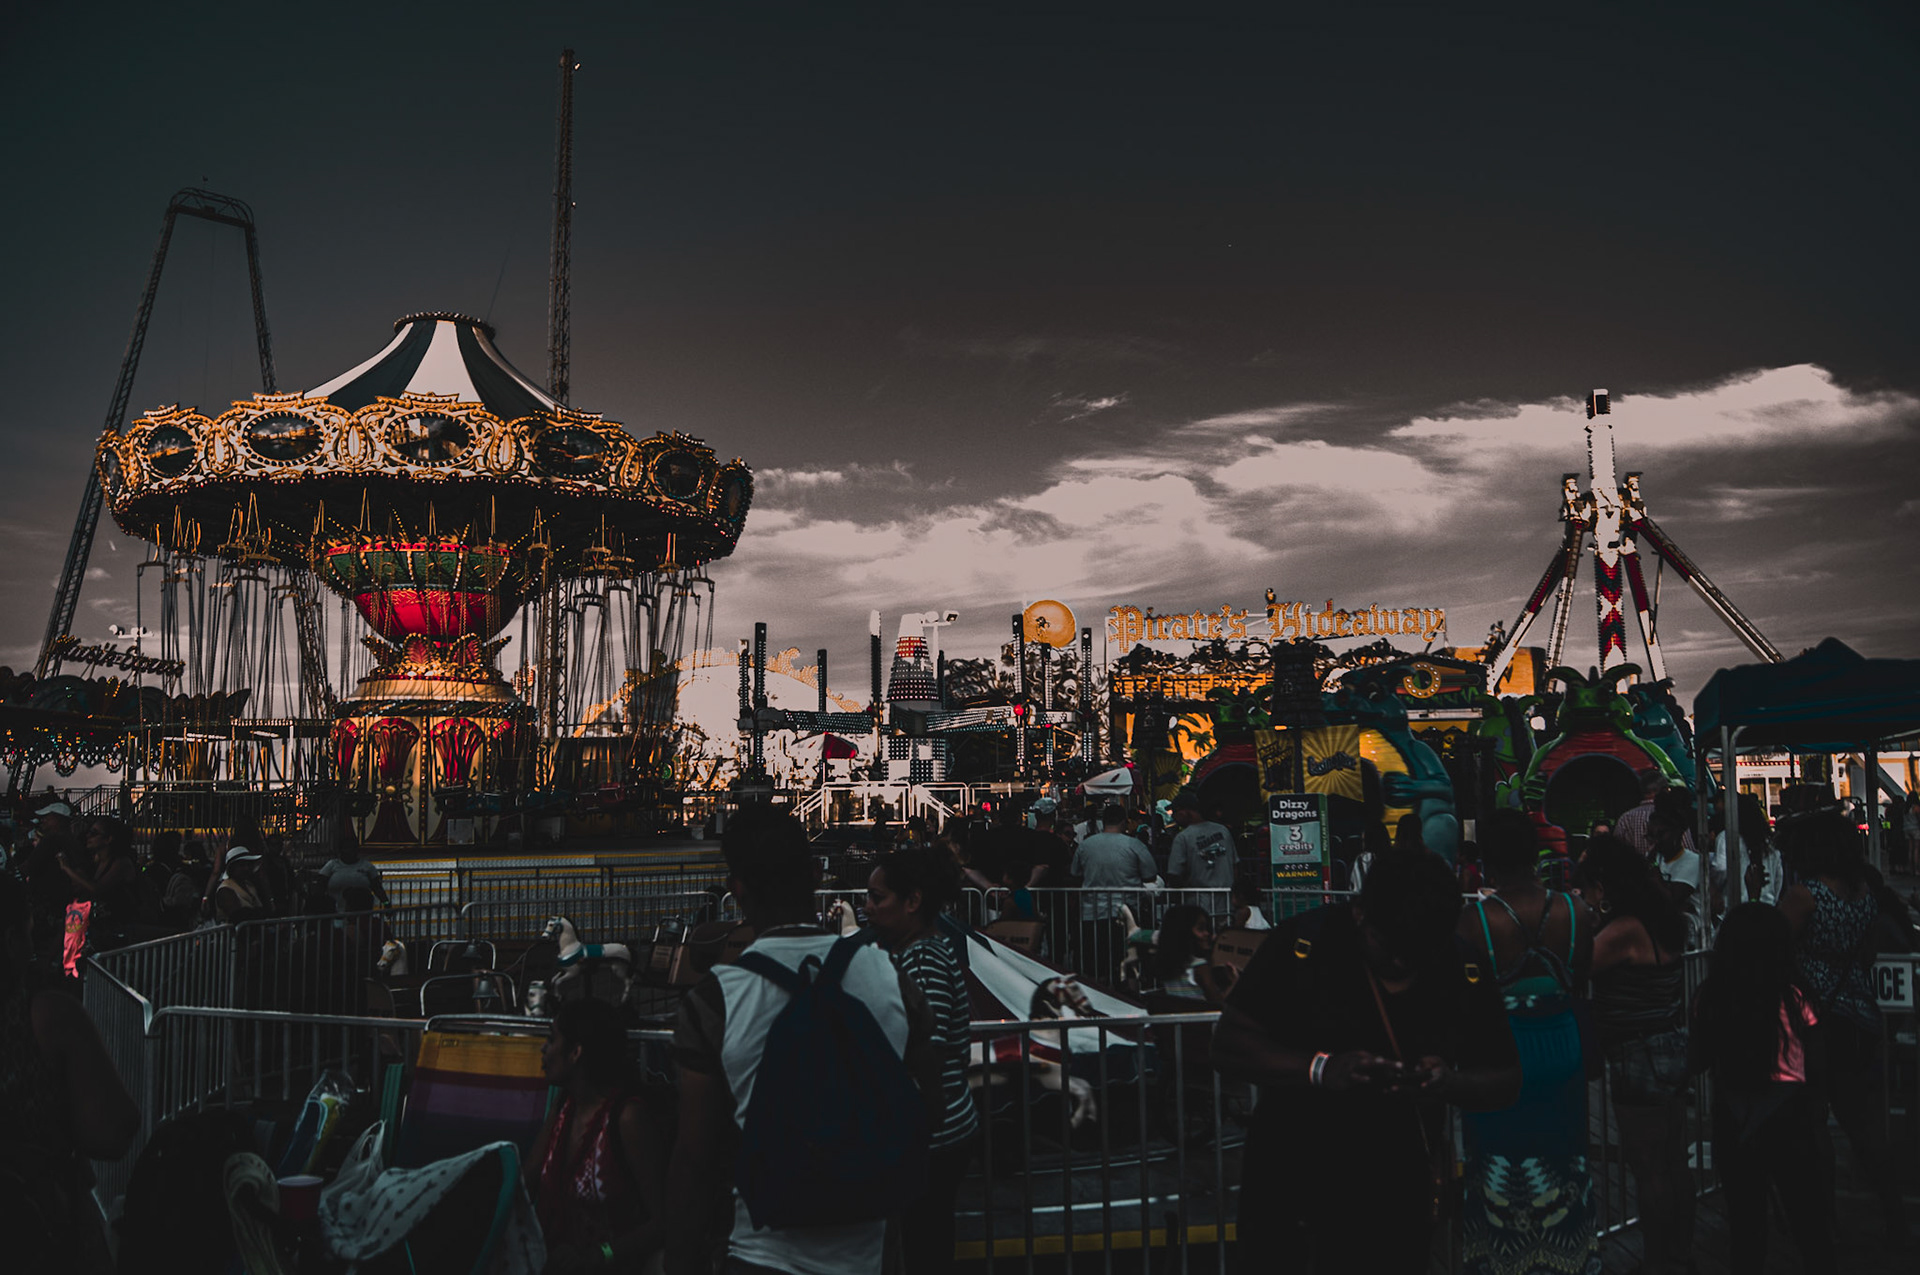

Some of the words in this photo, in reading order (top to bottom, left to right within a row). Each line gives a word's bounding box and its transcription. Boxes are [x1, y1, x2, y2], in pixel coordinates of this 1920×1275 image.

[1108, 604, 1248, 653] Pirate's
[1265, 599, 1445, 643] Hideaway
[1279, 800, 1309, 810] Dizzy
[1272, 809, 1318, 820] Dragons
[1289, 825, 1303, 841] 3
[1279, 842, 1314, 851] credits
[1276, 870, 1319, 878] WARNING
